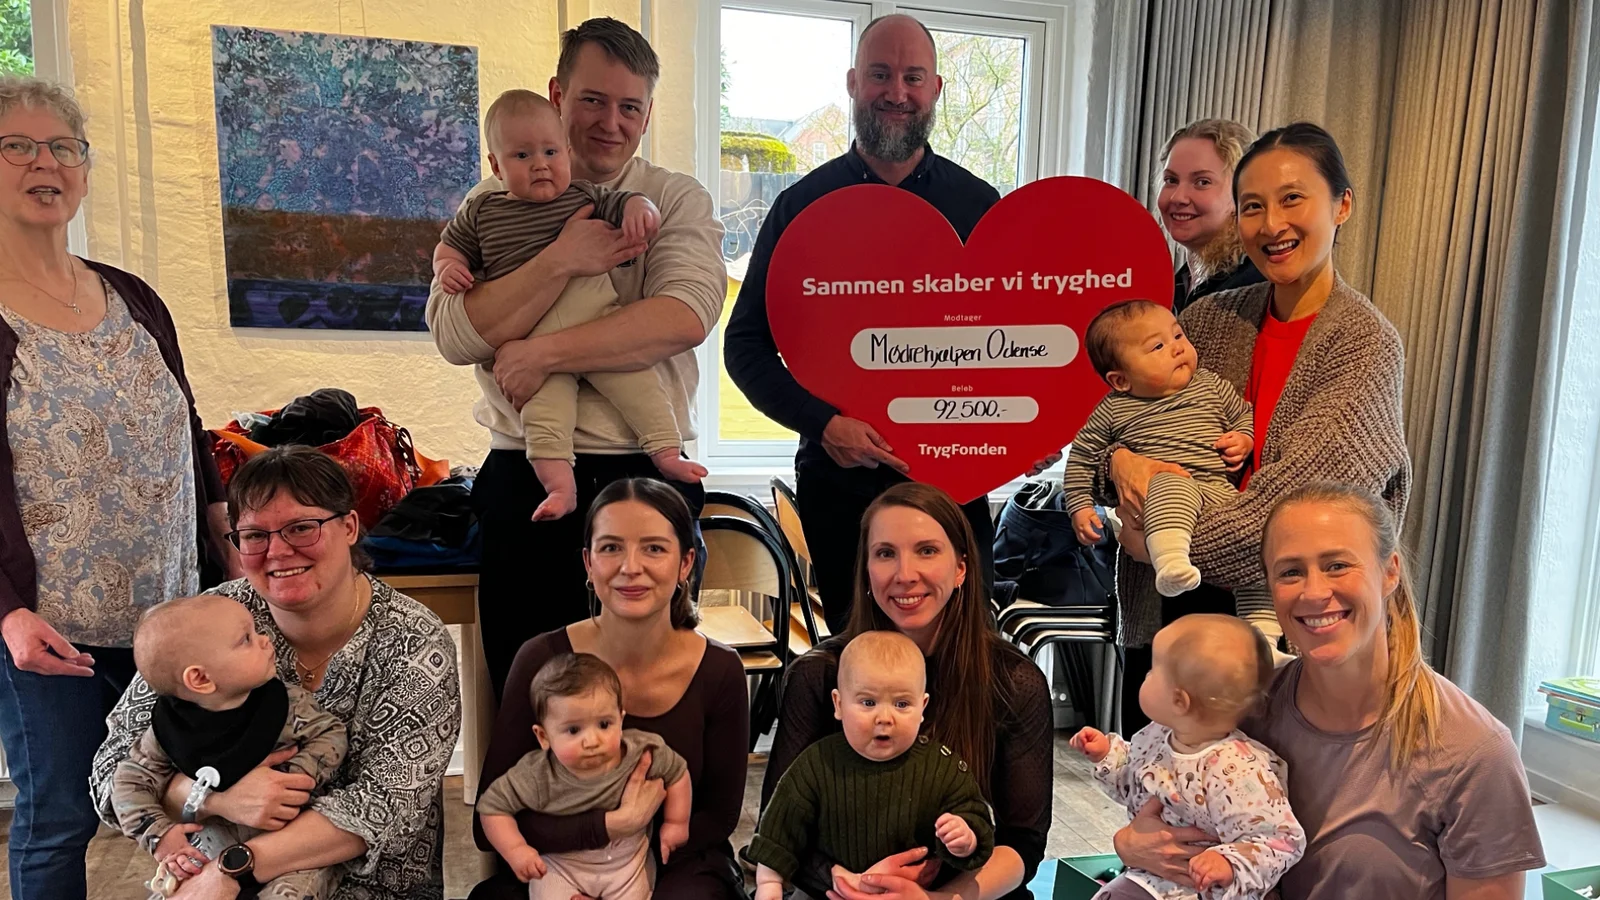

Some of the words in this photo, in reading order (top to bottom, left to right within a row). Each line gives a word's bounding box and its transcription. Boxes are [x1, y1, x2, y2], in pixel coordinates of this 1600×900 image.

[803, 276, 904, 297] Sammen
[913, 272, 994, 293] skaber
[1002, 271, 1023, 291] vi
[1031, 267, 1132, 294] tryghed
[943, 314, 982, 322] Modtager
[986, 328, 1049, 360] Odense
[918, 443, 1008, 459] TrygFonden
